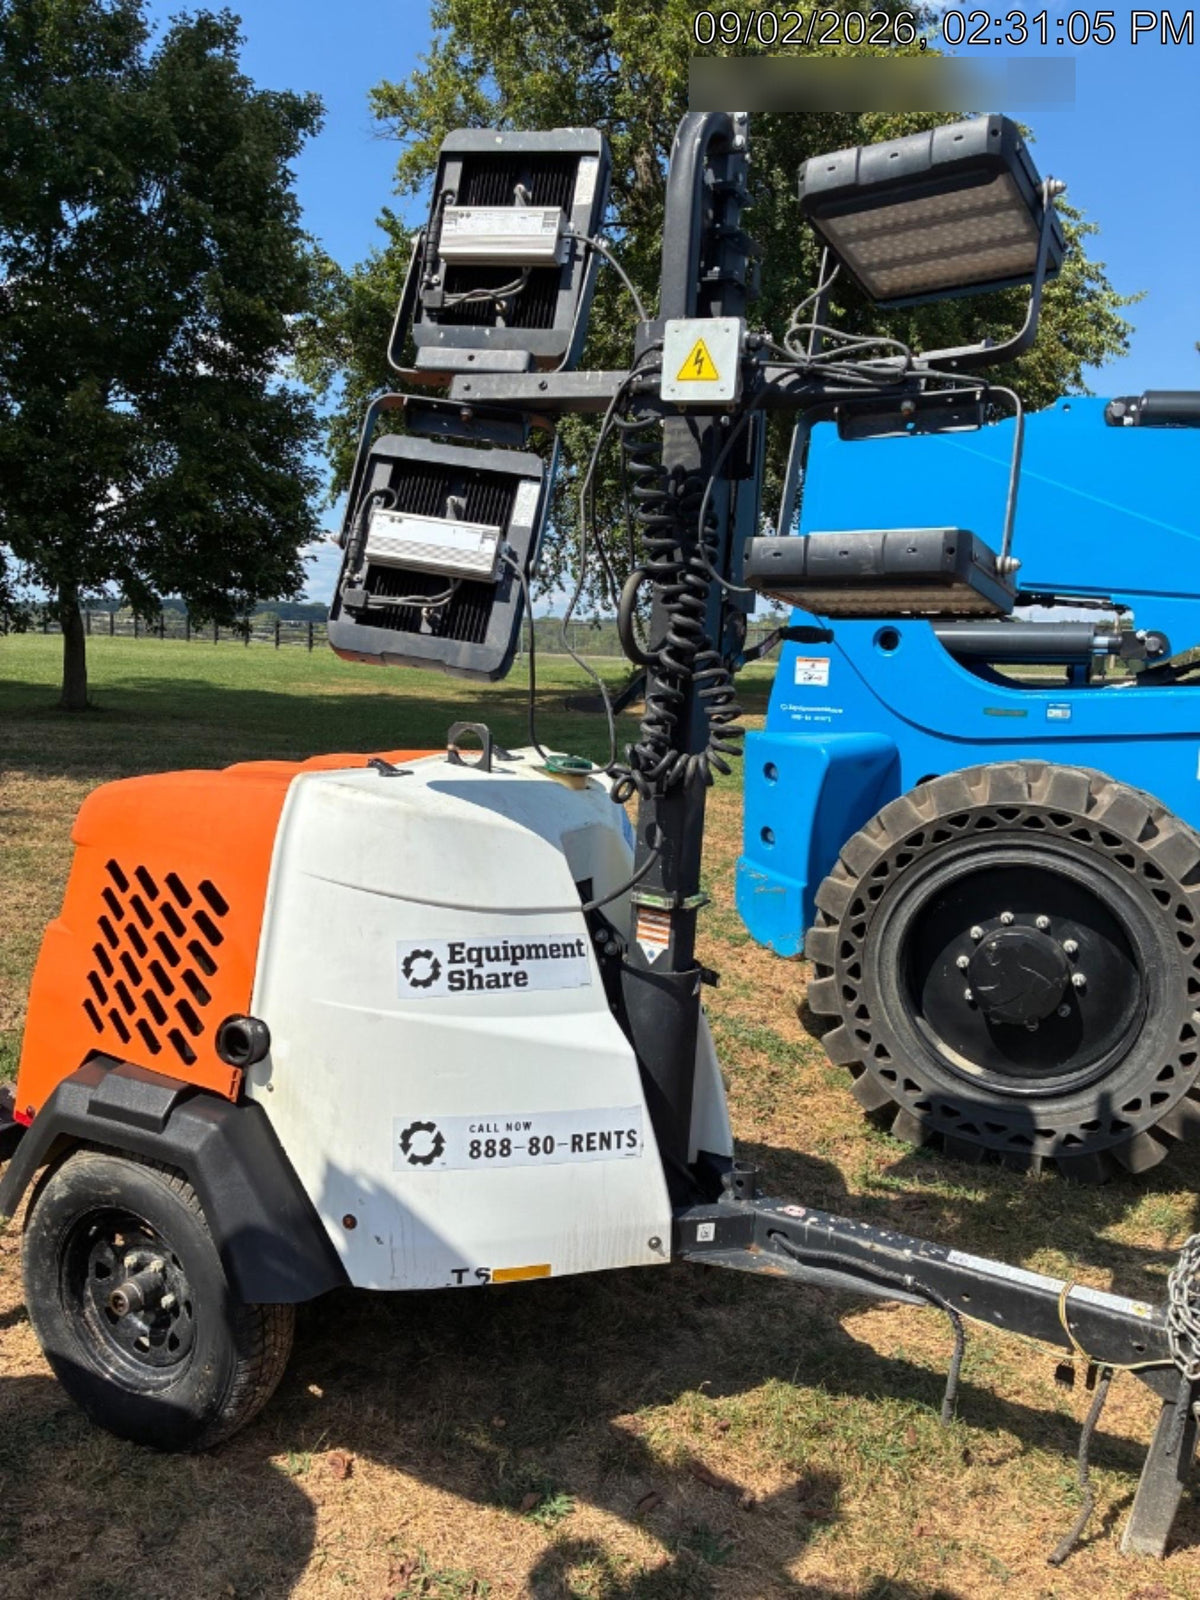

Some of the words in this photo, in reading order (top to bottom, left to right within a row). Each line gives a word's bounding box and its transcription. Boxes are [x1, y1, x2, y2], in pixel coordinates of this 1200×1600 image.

[447, 939, 586, 967] Equipment
[447, 968, 528, 992] Share
[469, 1123, 500, 1133] CALL
[506, 1121, 533, 1132] NOW
[469, 1128, 638, 1160] 888-80-RENTS
